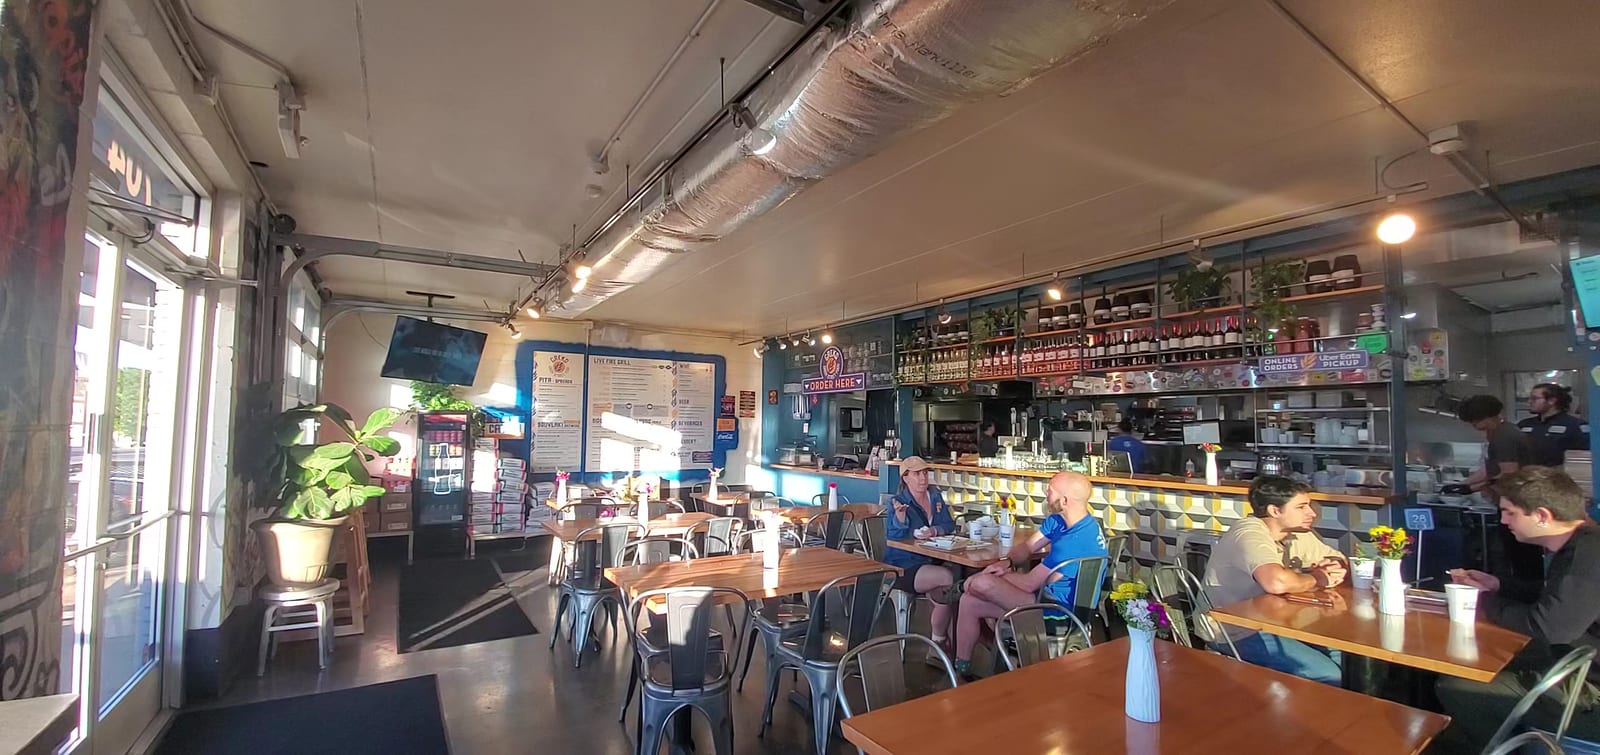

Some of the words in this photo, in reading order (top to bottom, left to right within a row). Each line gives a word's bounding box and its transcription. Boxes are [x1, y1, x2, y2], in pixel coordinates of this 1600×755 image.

[1264, 357, 1297, 365] ONLINE
[1322, 359, 1360, 367] PICKUP
[810, 381, 833, 390] ORDER
[835, 378, 855, 388] HERE
[1411, 514, 1427, 523] 28
